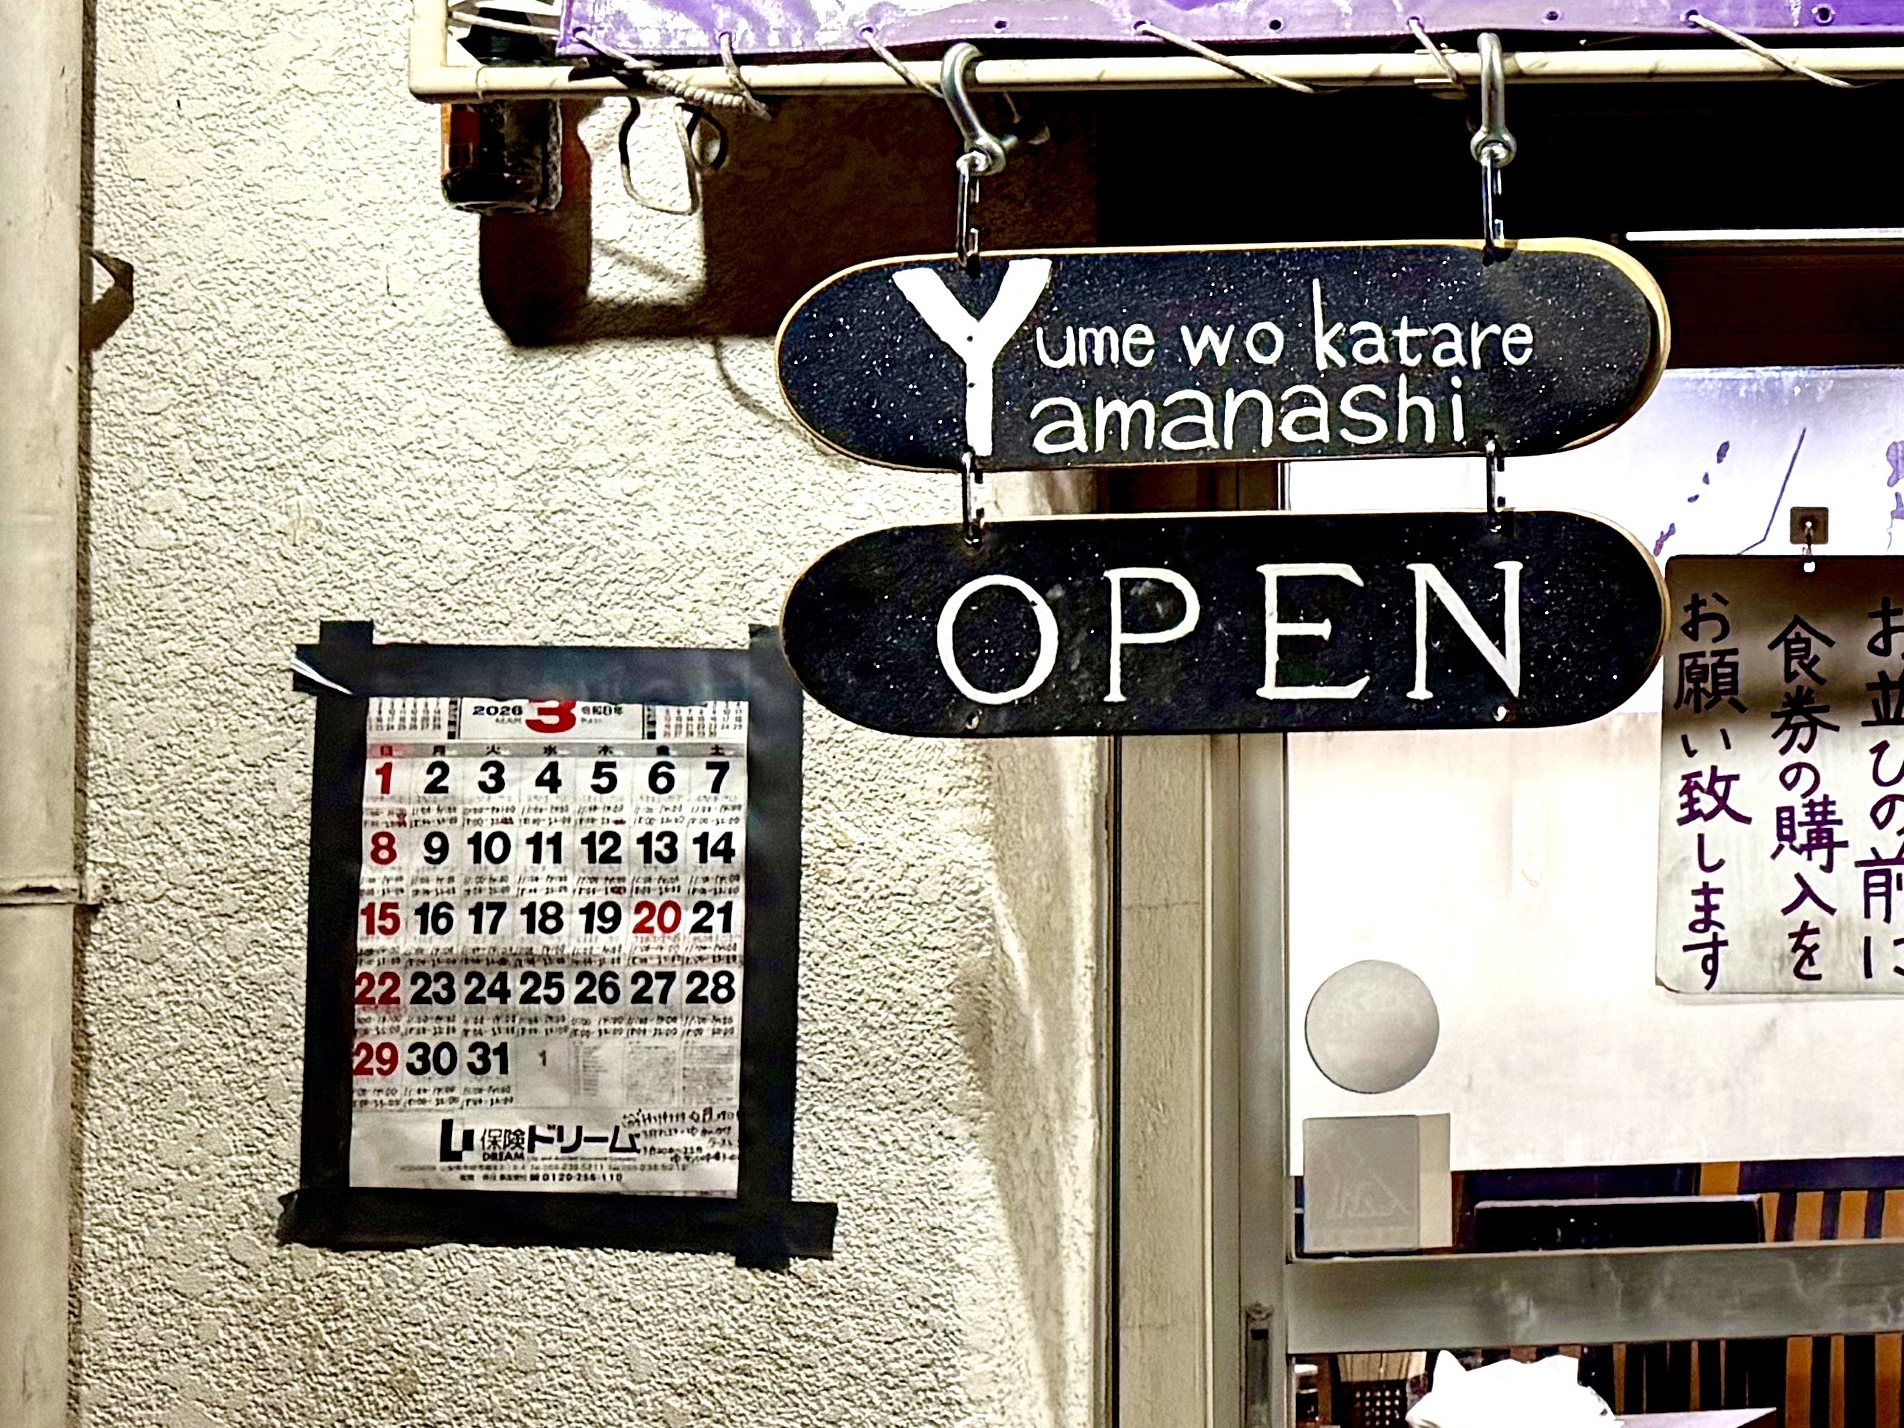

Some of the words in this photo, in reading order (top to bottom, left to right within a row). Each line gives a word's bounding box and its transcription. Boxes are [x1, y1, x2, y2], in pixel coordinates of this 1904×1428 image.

[1180, 320, 1285, 368] wo
[1313, 278, 1535, 372] katare
[936, 559, 1525, 708] OPEN
[525, 698, 577, 733] 3
[375, 761, 393, 794] 1
[424, 761, 450, 794] 2
[477, 761, 506, 794] 3
[535, 761, 562, 794] 4
[591, 761, 618, 794] 5
[648, 761, 675, 794] 6
[705, 761, 730, 794] 7
[1673, 592, 1753, 992] お願い致します
[1768, 615, 1849, 981] 食券の購入を
[370, 830, 397, 865] 8
[423, 830, 449, 865] 9
[467, 830, 511, 865] 10
[526, 830, 563, 865] 11
[581, 830, 622, 865] 12
[637, 830, 678, 865] 13
[692, 830, 735, 865] 14
[360, 900, 400, 935] 15
[415, 900, 454, 935] 16
[469, 900, 507, 935] 17
[520, 900, 564, 935] 18
[579, 900, 622, 935] 19
[632, 900, 682, 935] 20
[690, 900, 733, 935] 21
[354, 970, 401, 1004] 22
[410, 970, 456, 1004] 23
[464, 970, 511, 1004] 24
[519, 970, 565, 1004] 25
[574, 970, 621, 1004] 26
[630, 970, 677, 1004] 27
[685, 970, 735, 1004] 28
[353, 1041, 399, 1076] 29
[406, 1041, 457, 1076] 30
[467, 1041, 509, 1076] 31
[481, 1125, 640, 1153] 保険ドリーム
